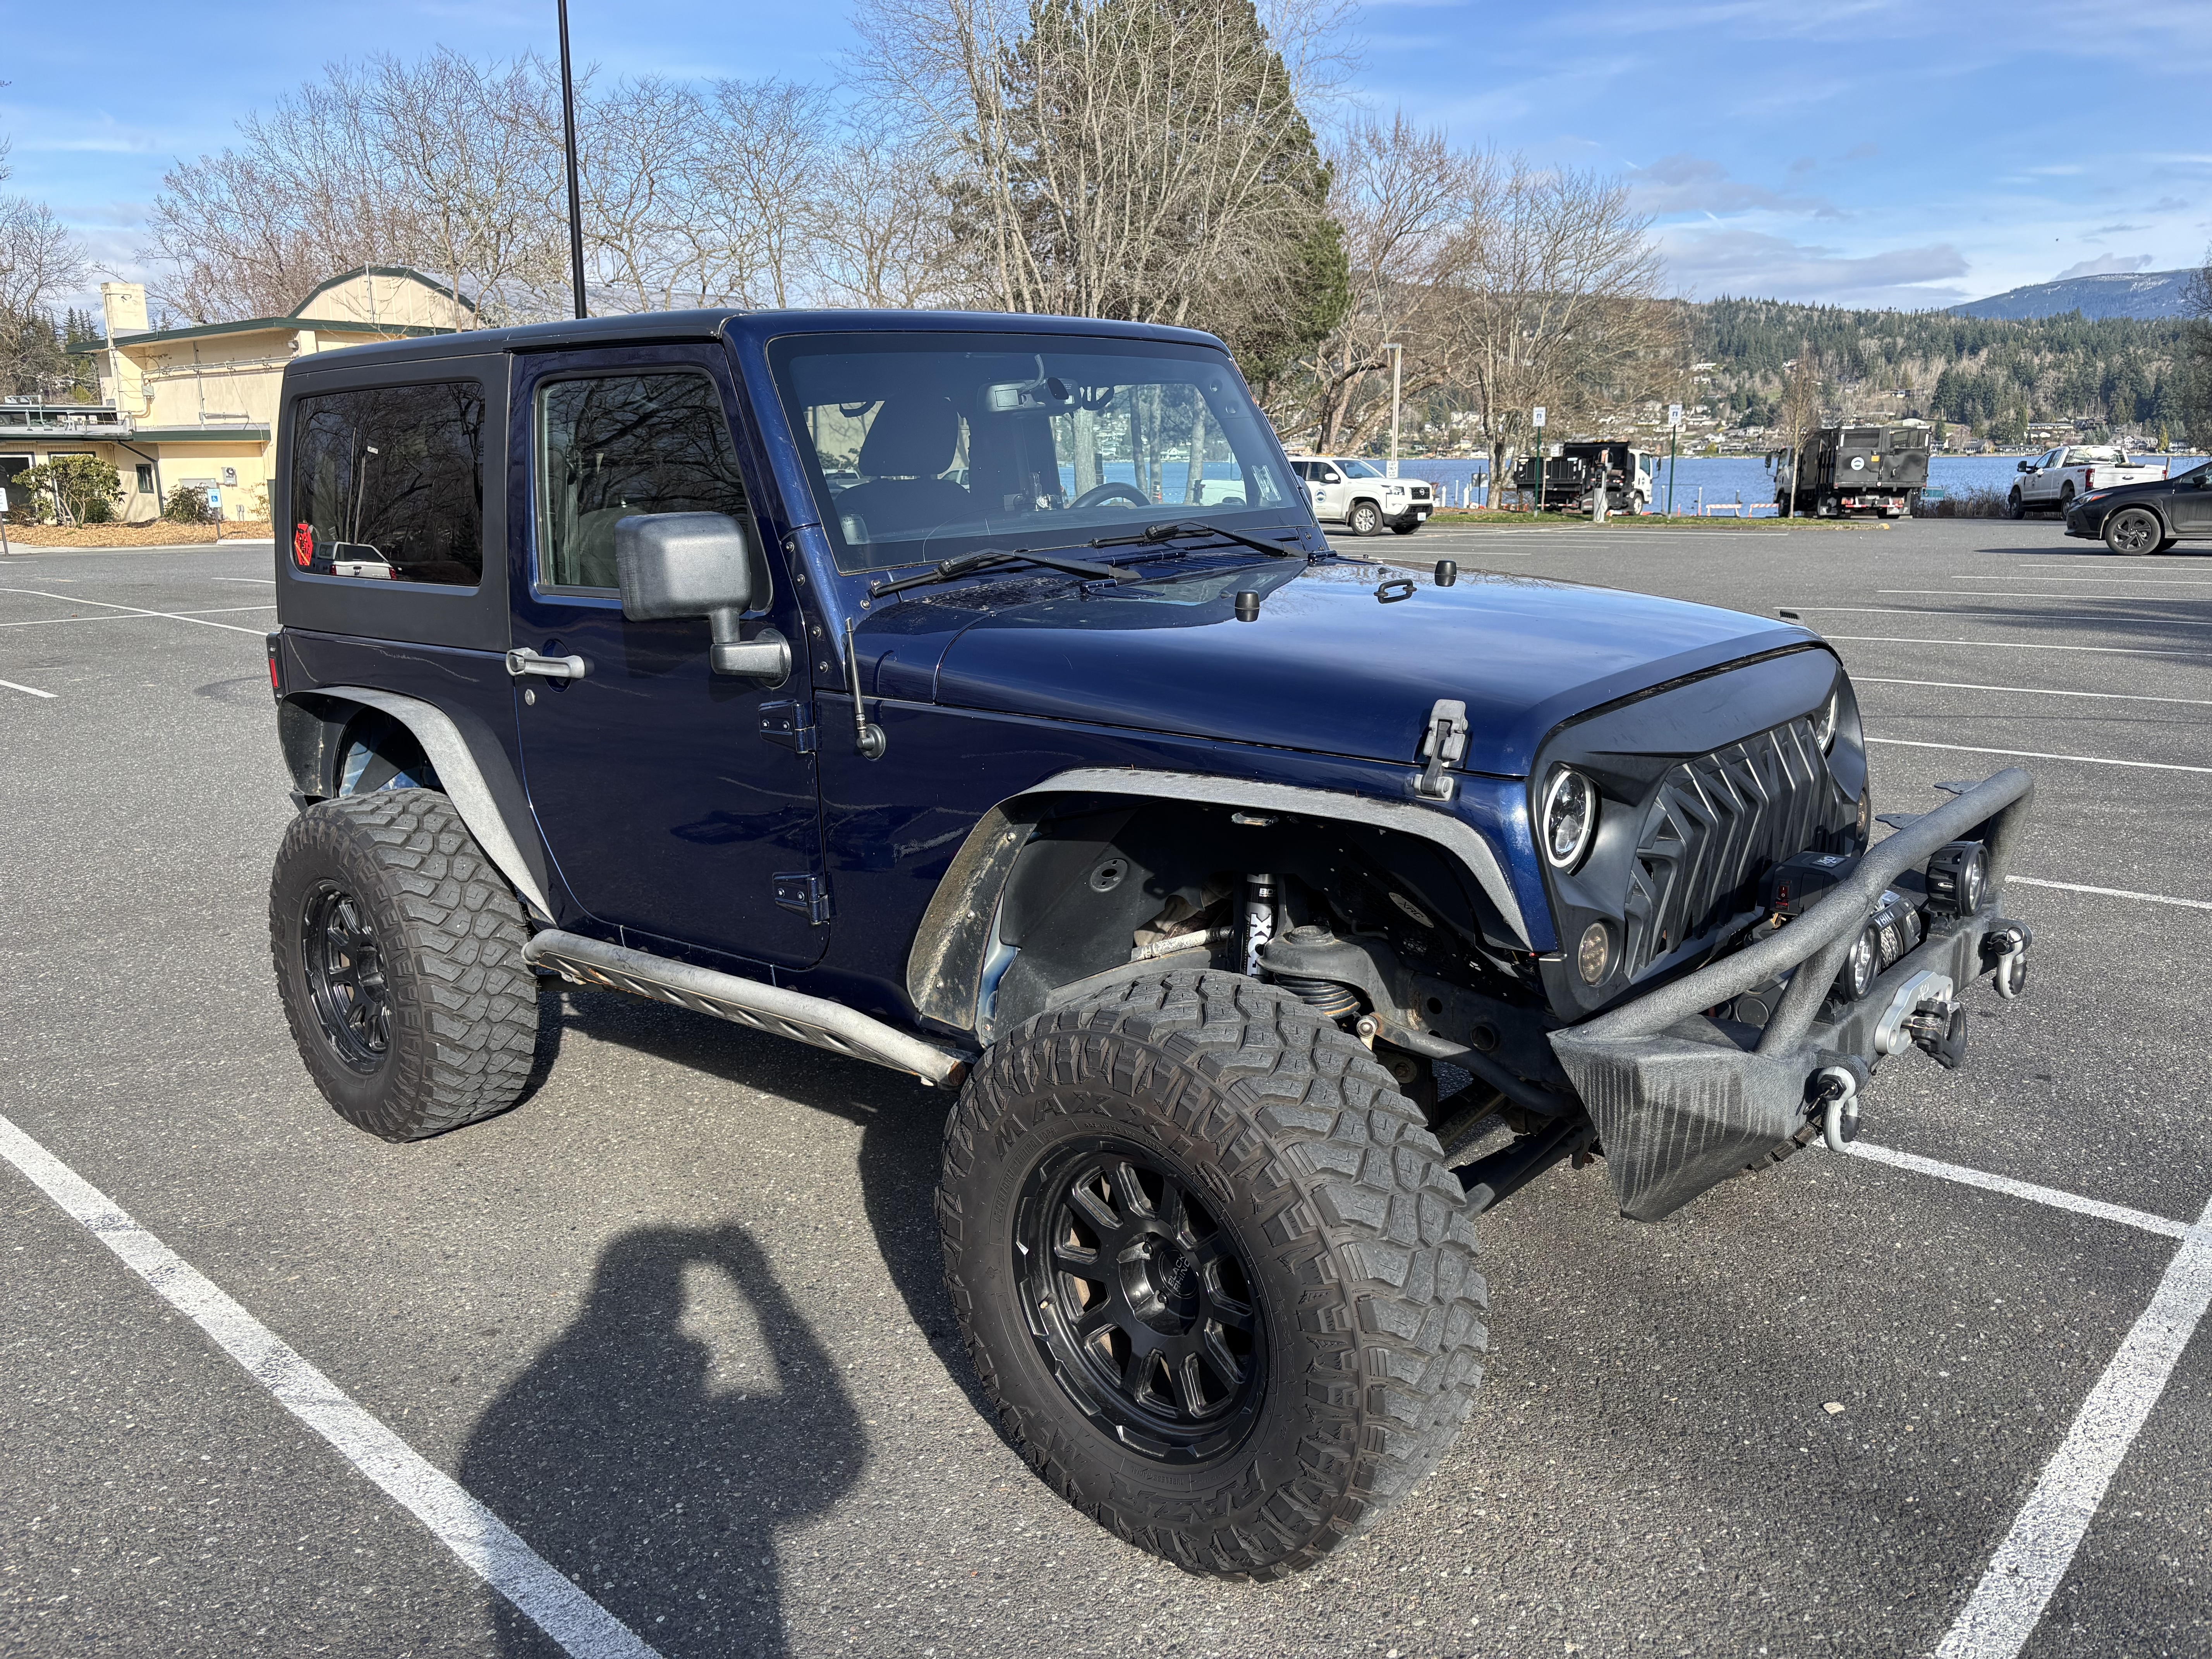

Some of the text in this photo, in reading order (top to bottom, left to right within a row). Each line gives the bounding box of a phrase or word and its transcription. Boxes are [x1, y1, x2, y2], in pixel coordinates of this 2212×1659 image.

[1398, 902, 1424, 918] XRC
[1247, 914, 1272, 977] FOX
[1168, 1253, 1185, 1286] BLACK
[1173, 1259, 1190, 1294] RHINO
[1109, 1460, 1266, 1524] RAZR
[1131, 1466, 1184, 1486] TUBELESS RADIAL
